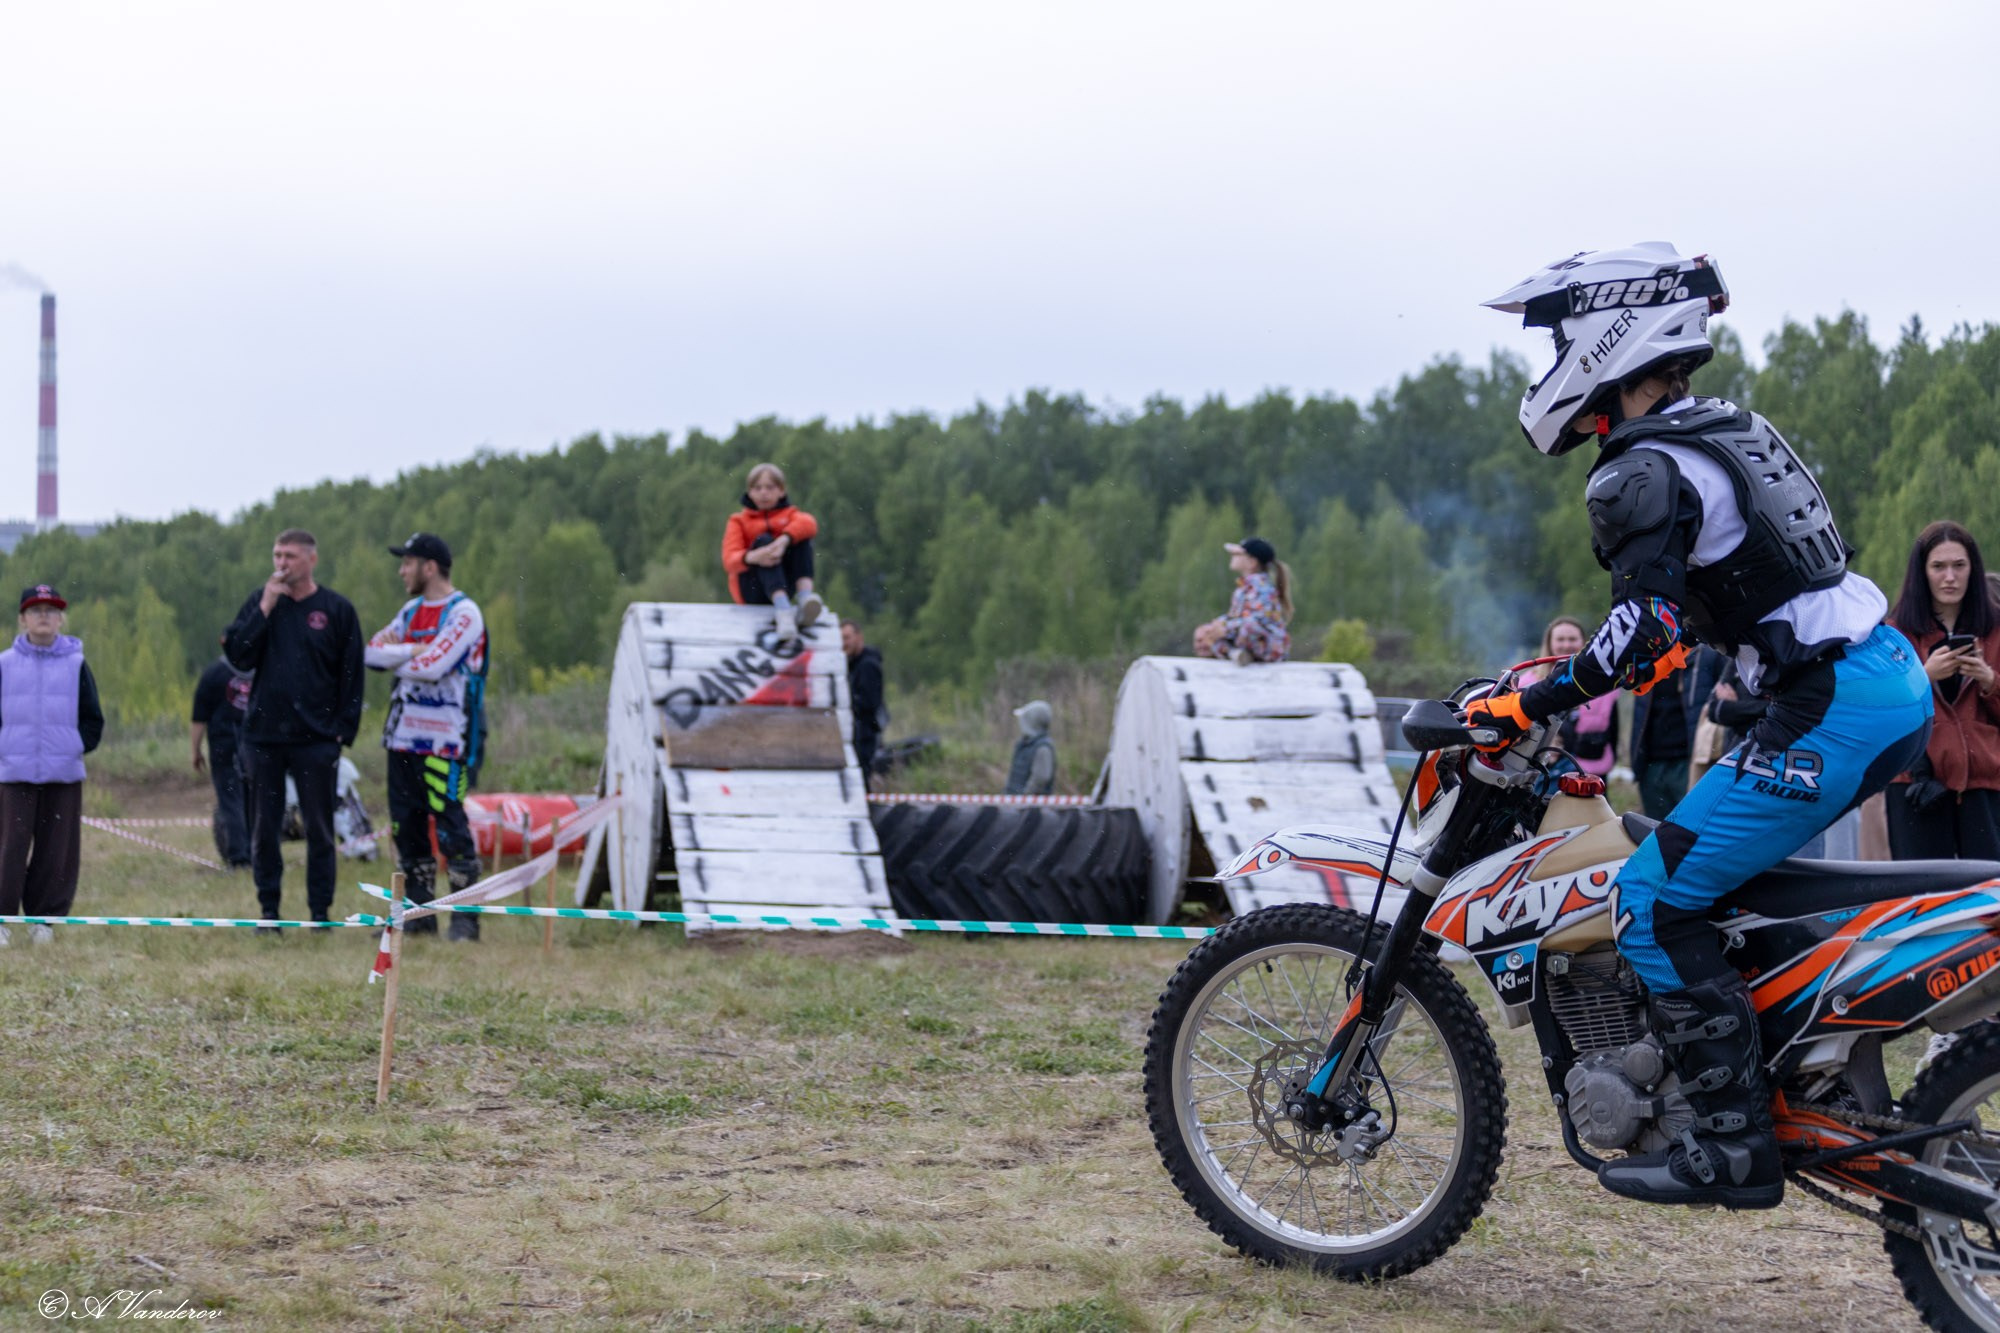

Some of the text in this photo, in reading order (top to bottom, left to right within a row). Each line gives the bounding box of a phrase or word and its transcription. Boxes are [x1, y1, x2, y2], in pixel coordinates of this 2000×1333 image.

[1574, 273, 1689, 313] 100%
[1590, 308, 1639, 364] HIZER
[1751, 779, 1823, 803] RACING
[1465, 862, 1624, 948] KAYO
[1496, 971, 1531, 992] K1 MX
